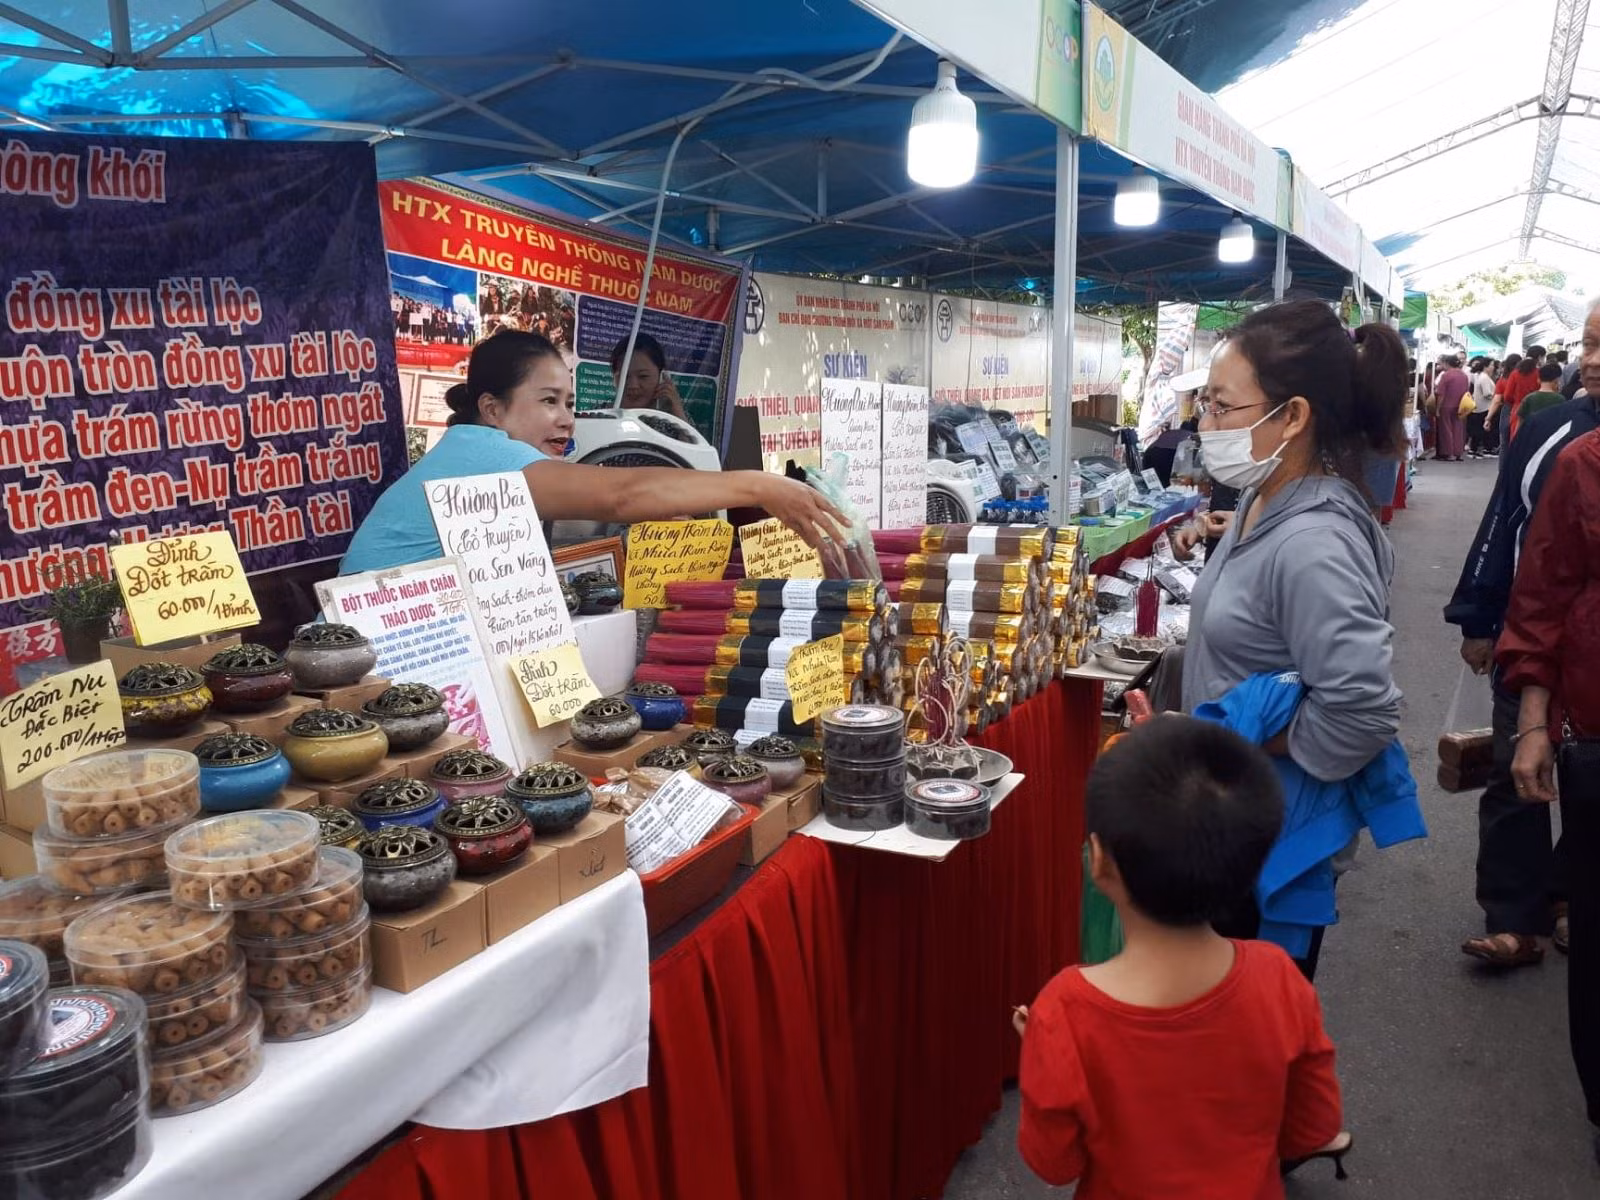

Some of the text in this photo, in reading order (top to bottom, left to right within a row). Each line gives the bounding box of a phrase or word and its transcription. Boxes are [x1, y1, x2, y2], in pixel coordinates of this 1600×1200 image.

[0, 140, 166, 207] ông khói
[393, 190, 723, 297] HTX TRUYỀN THỐNG NAM DƯỢC
[441, 237, 515, 272] LÀNG
[521, 257, 583, 287] NGHỀ
[656, 289, 693, 313] NAM
[8, 272, 262, 341] đồng xu tài lộc
[78, 341, 157, 395] tròn
[164, 333, 245, 392] đồng
[248, 343, 285, 382] xu
[291, 332, 328, 378] tài
[332, 330, 375, 381] lộc
[73, 404, 159, 459] trám
[166, 399, 244, 451] rừng
[249, 393, 315, 438] thơm
[323, 383, 385, 433] ngát
[761, 393, 792, 420] THIỆU,
[795, 389, 820, 416] QUẢN
[762, 434, 777, 457] TẠI
[4, 470, 101, 533] trầm
[236, 443, 303, 496] trầm
[307, 434, 381, 484] trắng
[230, 496, 304, 552] Thần
[307, 491, 353, 538] tài
[147, 539, 212, 567] Đỉnh
[466, 562, 487, 585] oa
[1474, 555, 1485, 577] NIKE
[128, 566, 171, 597] Đốt
[341, 574, 457, 615] BỘT THUỐC NGÂM CHÂN
[381, 603, 436, 629] THẢO DƯỢC
[69, 674, 107, 697] Nụ
[525, 681, 555, 702] Đốt
[22, 698, 103, 740] Đặc Biệt
